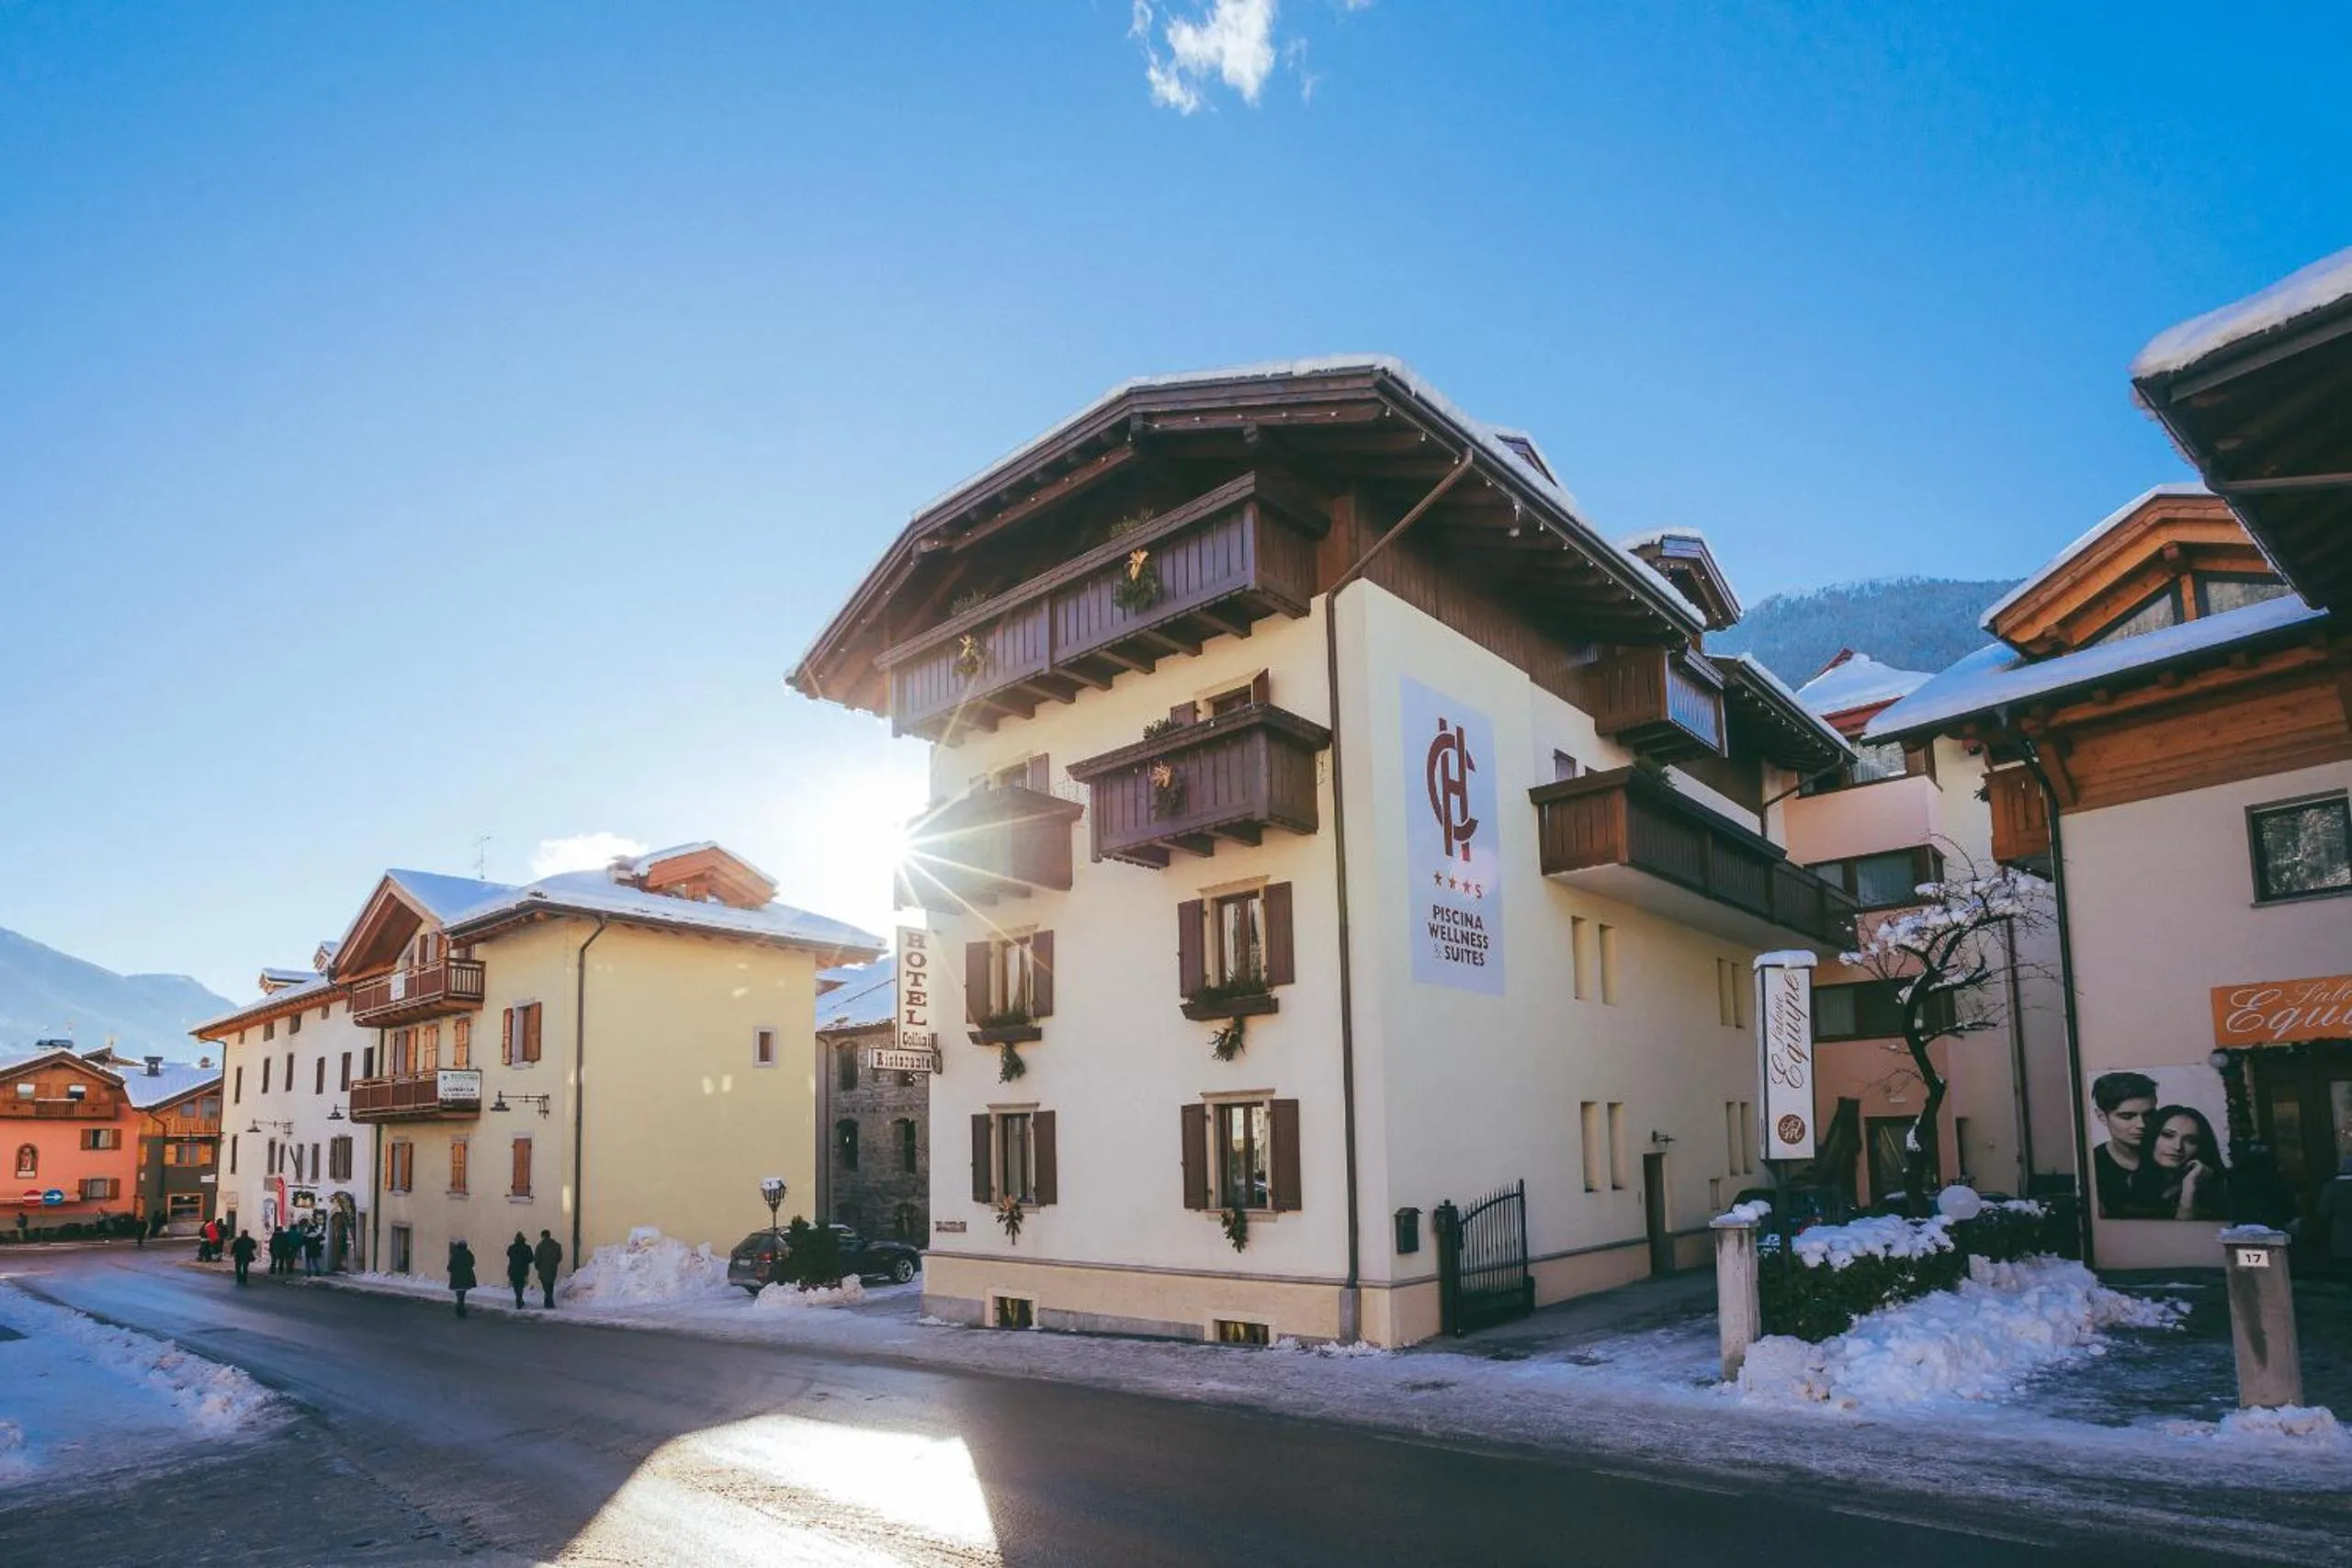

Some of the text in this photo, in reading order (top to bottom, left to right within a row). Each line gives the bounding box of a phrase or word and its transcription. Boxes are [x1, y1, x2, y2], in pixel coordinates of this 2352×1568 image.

[1432, 904, 1484, 931] PISCINA
[1428, 921, 1489, 950] WELLNESS
[1444, 945, 1485, 966] SUITES
[905, 931, 927, 1026] HOTEL
[1770, 972, 1808, 1089] Equipe
[2245, 1253, 2262, 1264] 17
